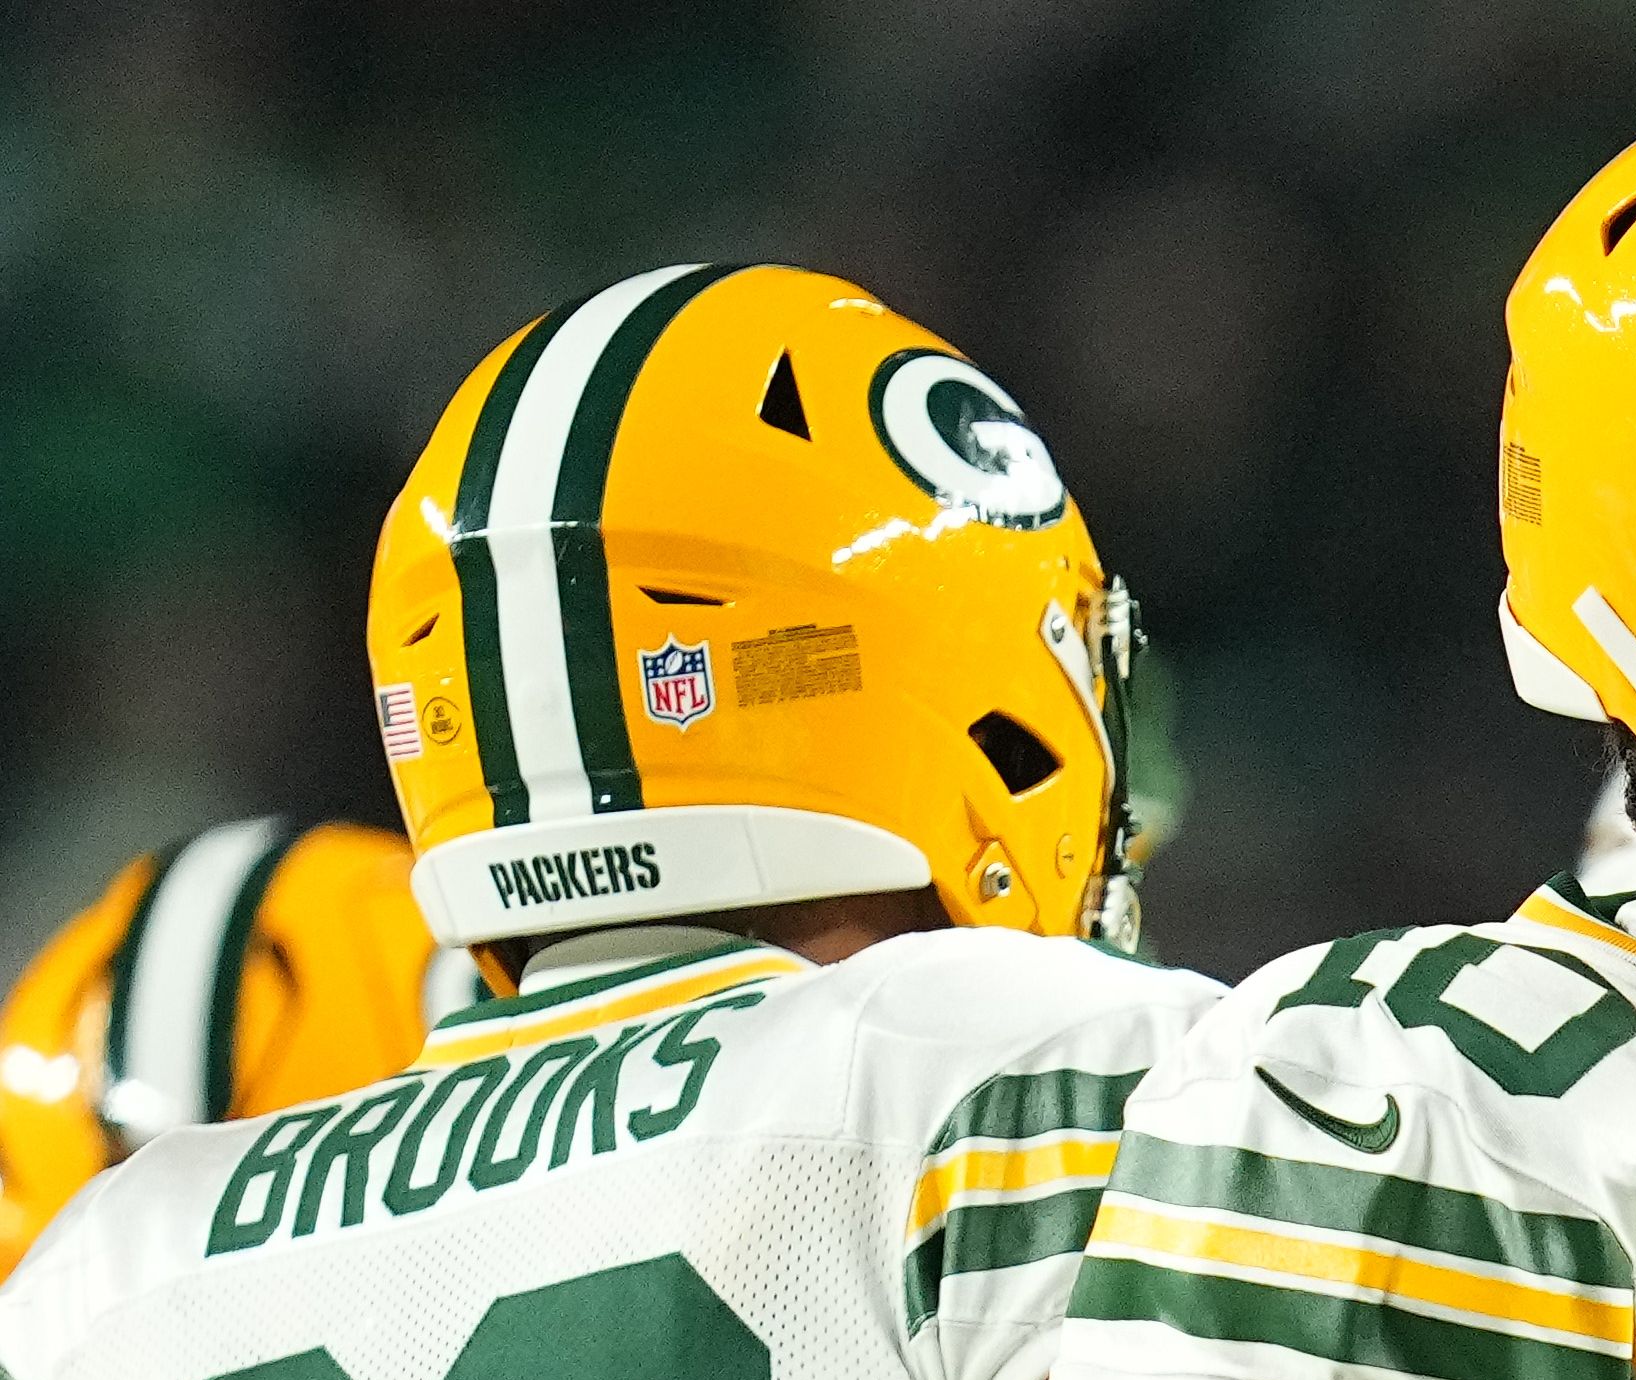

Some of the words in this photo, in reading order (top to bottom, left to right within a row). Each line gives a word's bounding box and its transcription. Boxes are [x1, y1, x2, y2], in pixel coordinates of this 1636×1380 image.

[652, 676, 705, 714] NFL
[489, 842, 660, 909] PACKERS
[204, 991, 766, 1258] BROOKS
